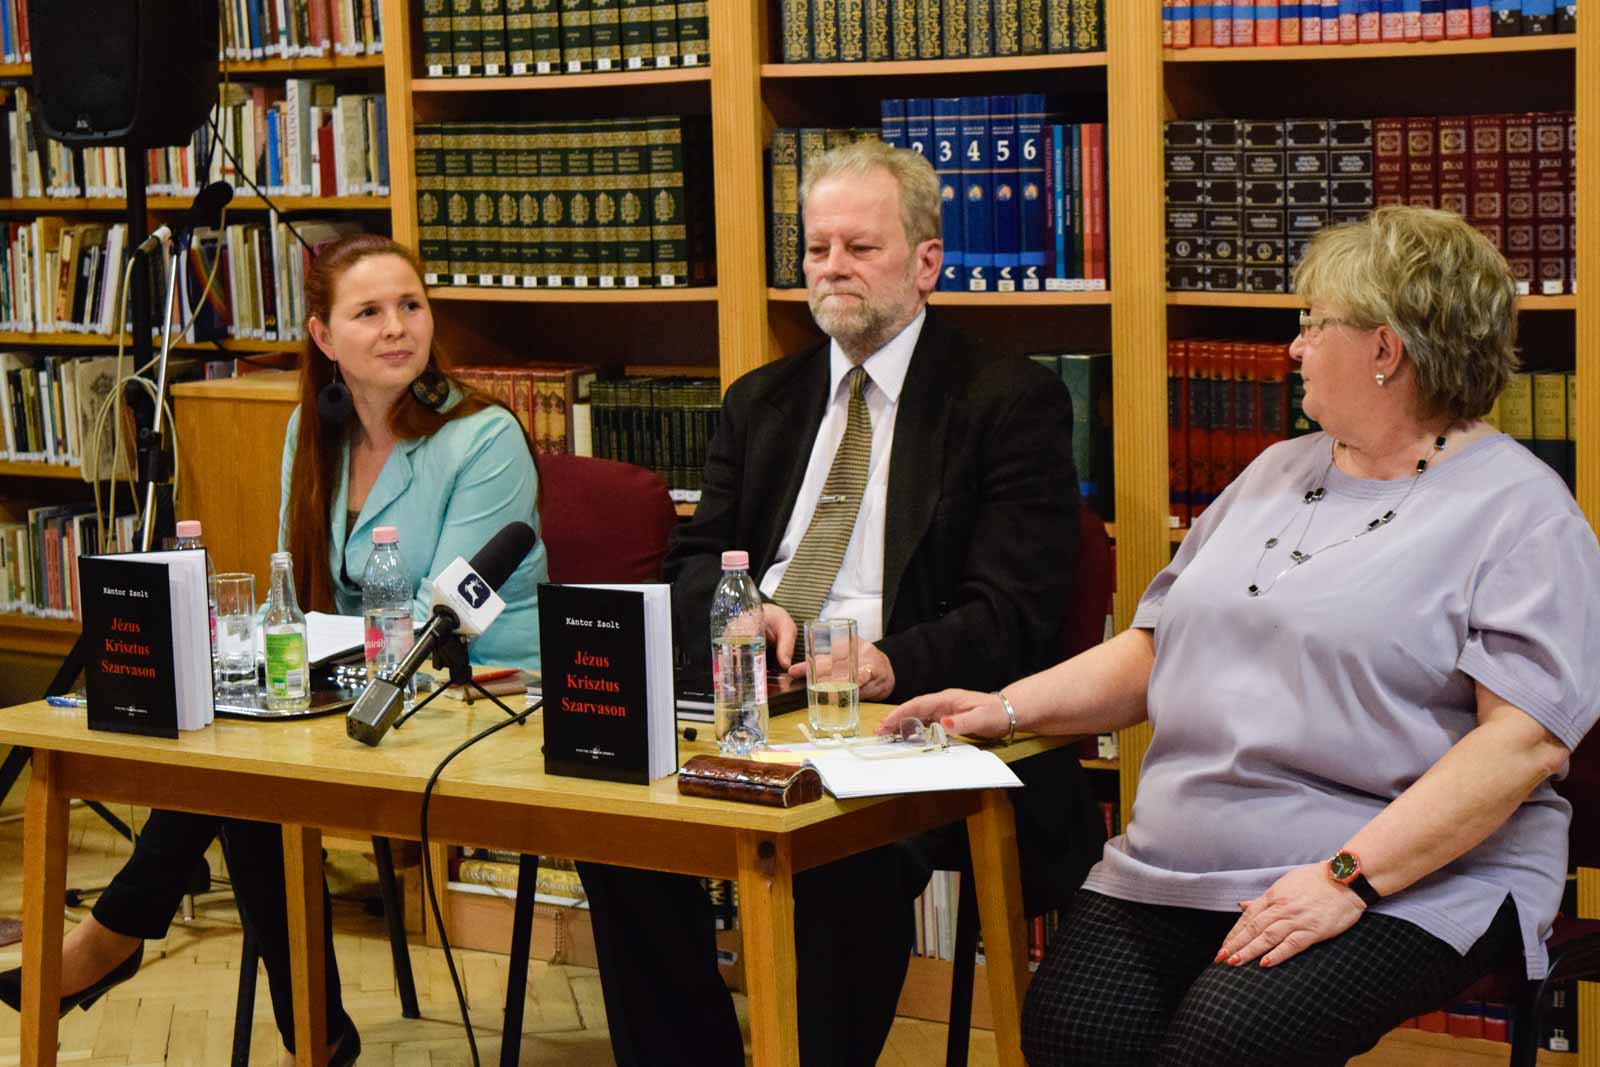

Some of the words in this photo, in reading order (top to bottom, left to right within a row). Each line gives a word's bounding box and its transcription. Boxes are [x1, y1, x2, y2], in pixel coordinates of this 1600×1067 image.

[939, 140, 952, 162] 3
[967, 140, 980, 161] 4
[996, 140, 1010, 161] 5
[1023, 138, 1037, 160] 6
[103, 587, 126, 596] Kántor
[129, 589, 149, 598] Zsolt
[111, 617, 141, 632] Jézus
[565, 617, 593, 627] Kántor
[597, 619, 620, 629] Zsolt
[105, 638, 150, 655] Krisztus
[101, 658, 156, 678] Szarvason
[574, 650, 609, 668] Jézus
[567, 673, 620, 692] Krisztus
[561, 696, 626, 717] Szarvason
